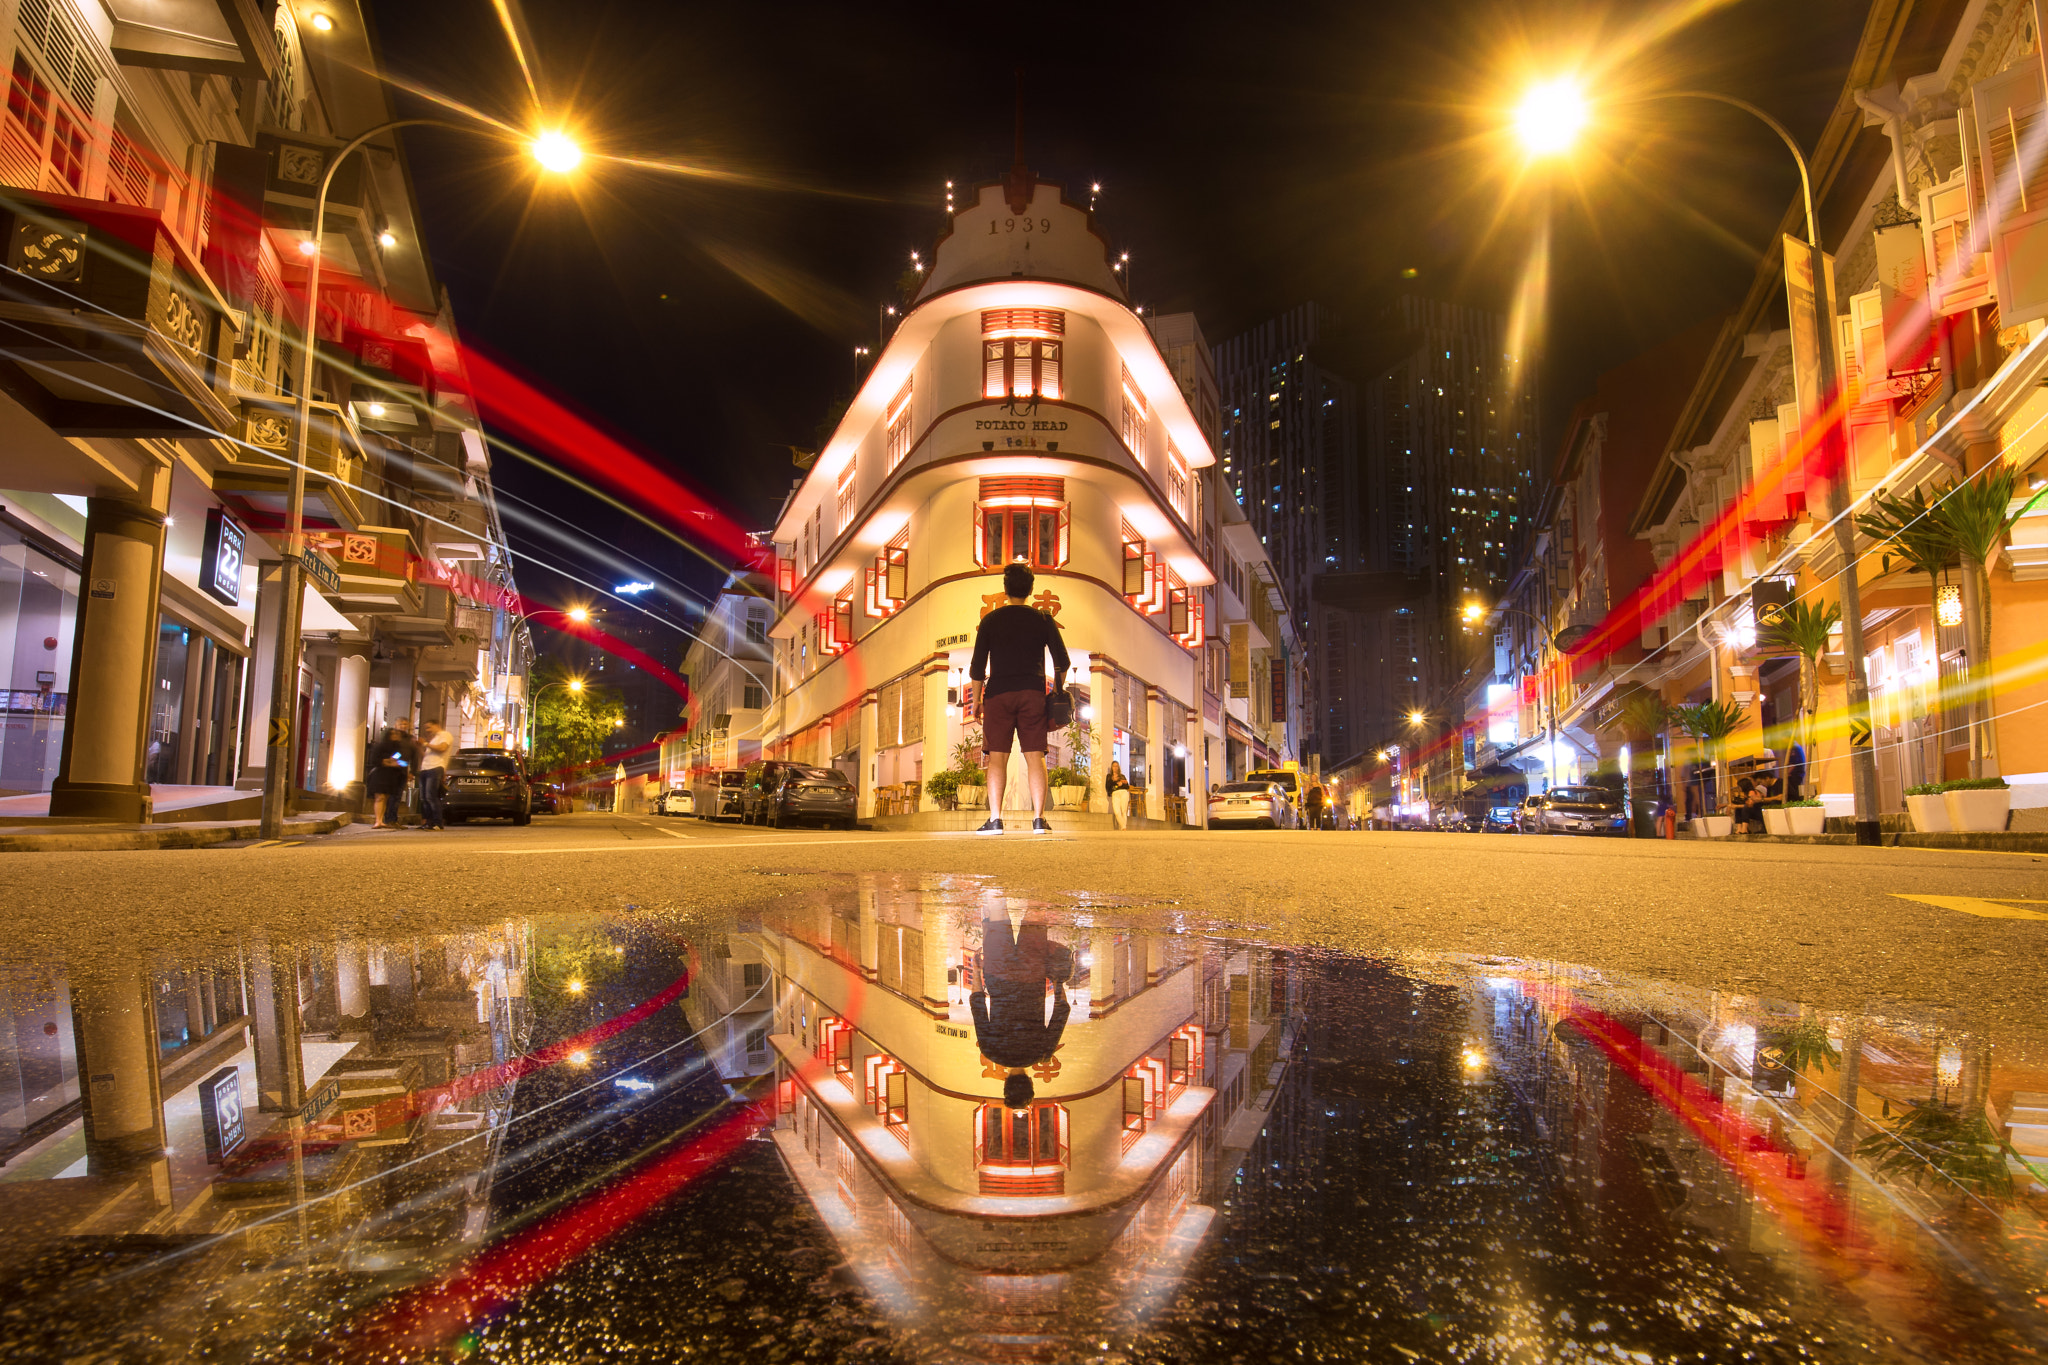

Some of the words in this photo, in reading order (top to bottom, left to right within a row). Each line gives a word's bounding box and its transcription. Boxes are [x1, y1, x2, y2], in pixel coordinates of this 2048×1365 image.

[988, 217, 1051, 235] 1939
[976, 420, 1026, 430] POTATO
[1032, 421, 1068, 431] HEAD
[224, 526, 242, 550] PARK
[220, 542, 239, 582] 22
[218, 574, 237, 594] hotel
[319, 560, 330, 580] Lim
[330, 573, 338, 591] Rd
[947, 636, 958, 645] LIM
[960, 634, 968, 643] RD
